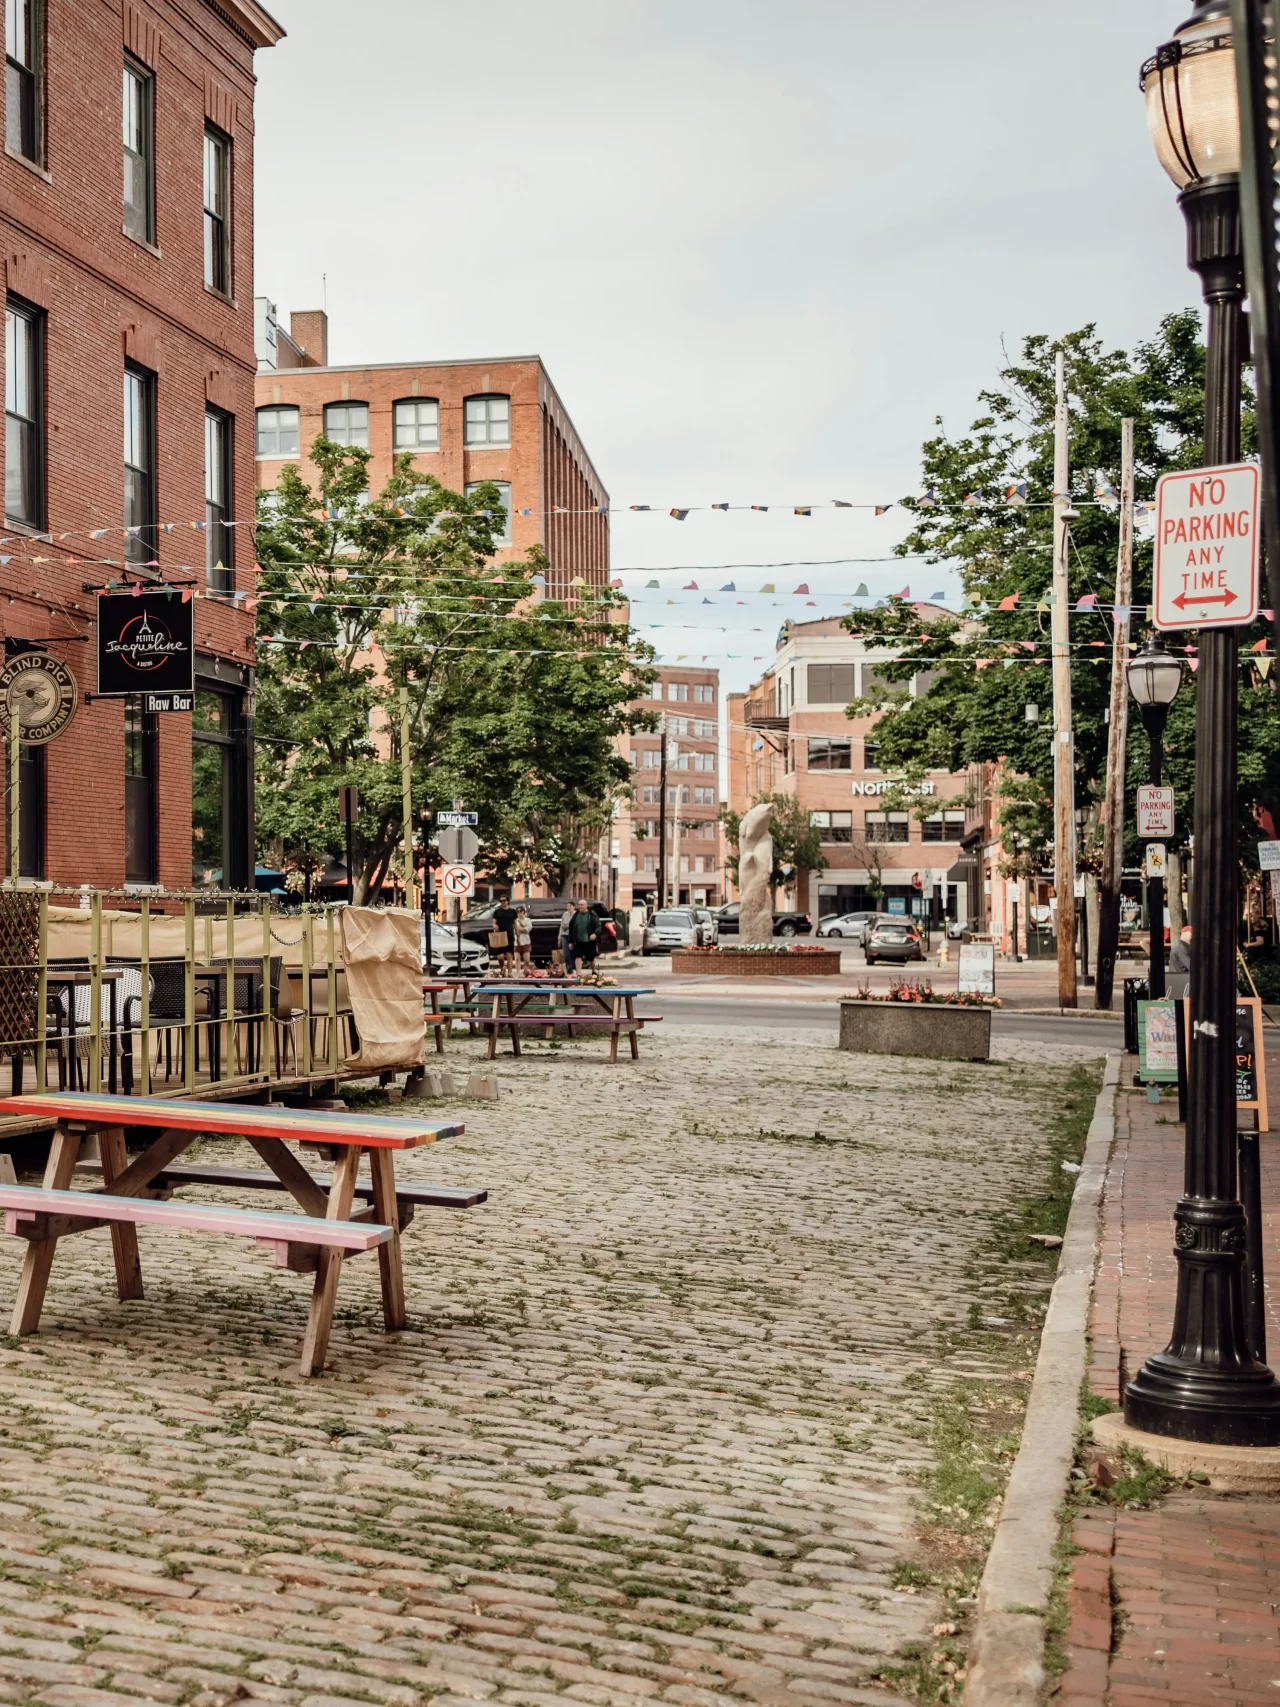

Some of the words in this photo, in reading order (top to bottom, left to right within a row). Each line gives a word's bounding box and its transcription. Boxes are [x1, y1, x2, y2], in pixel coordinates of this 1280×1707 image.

[1189, 479, 1225, 508] NO
[1164, 510, 1249, 545] PARKING
[1186, 546, 1224, 567] ANY
[1181, 570, 1228, 591] TIME
[105, 632, 188, 659] Jacqueline
[136, 634, 154, 642] PETITE
[1, 657, 42, 685] BLIND
[44, 660, 68, 683] PIG
[148, 696, 169, 711] Raw
[173, 695, 191, 710] Bar
[28, 701, 71, 739] COMPANY
[1140, 801, 1171, 810] PARKING
[1148, 790, 1162, 800] NO
[446, 813, 470, 824] Market
[1148, 818, 1164, 826] TIME
